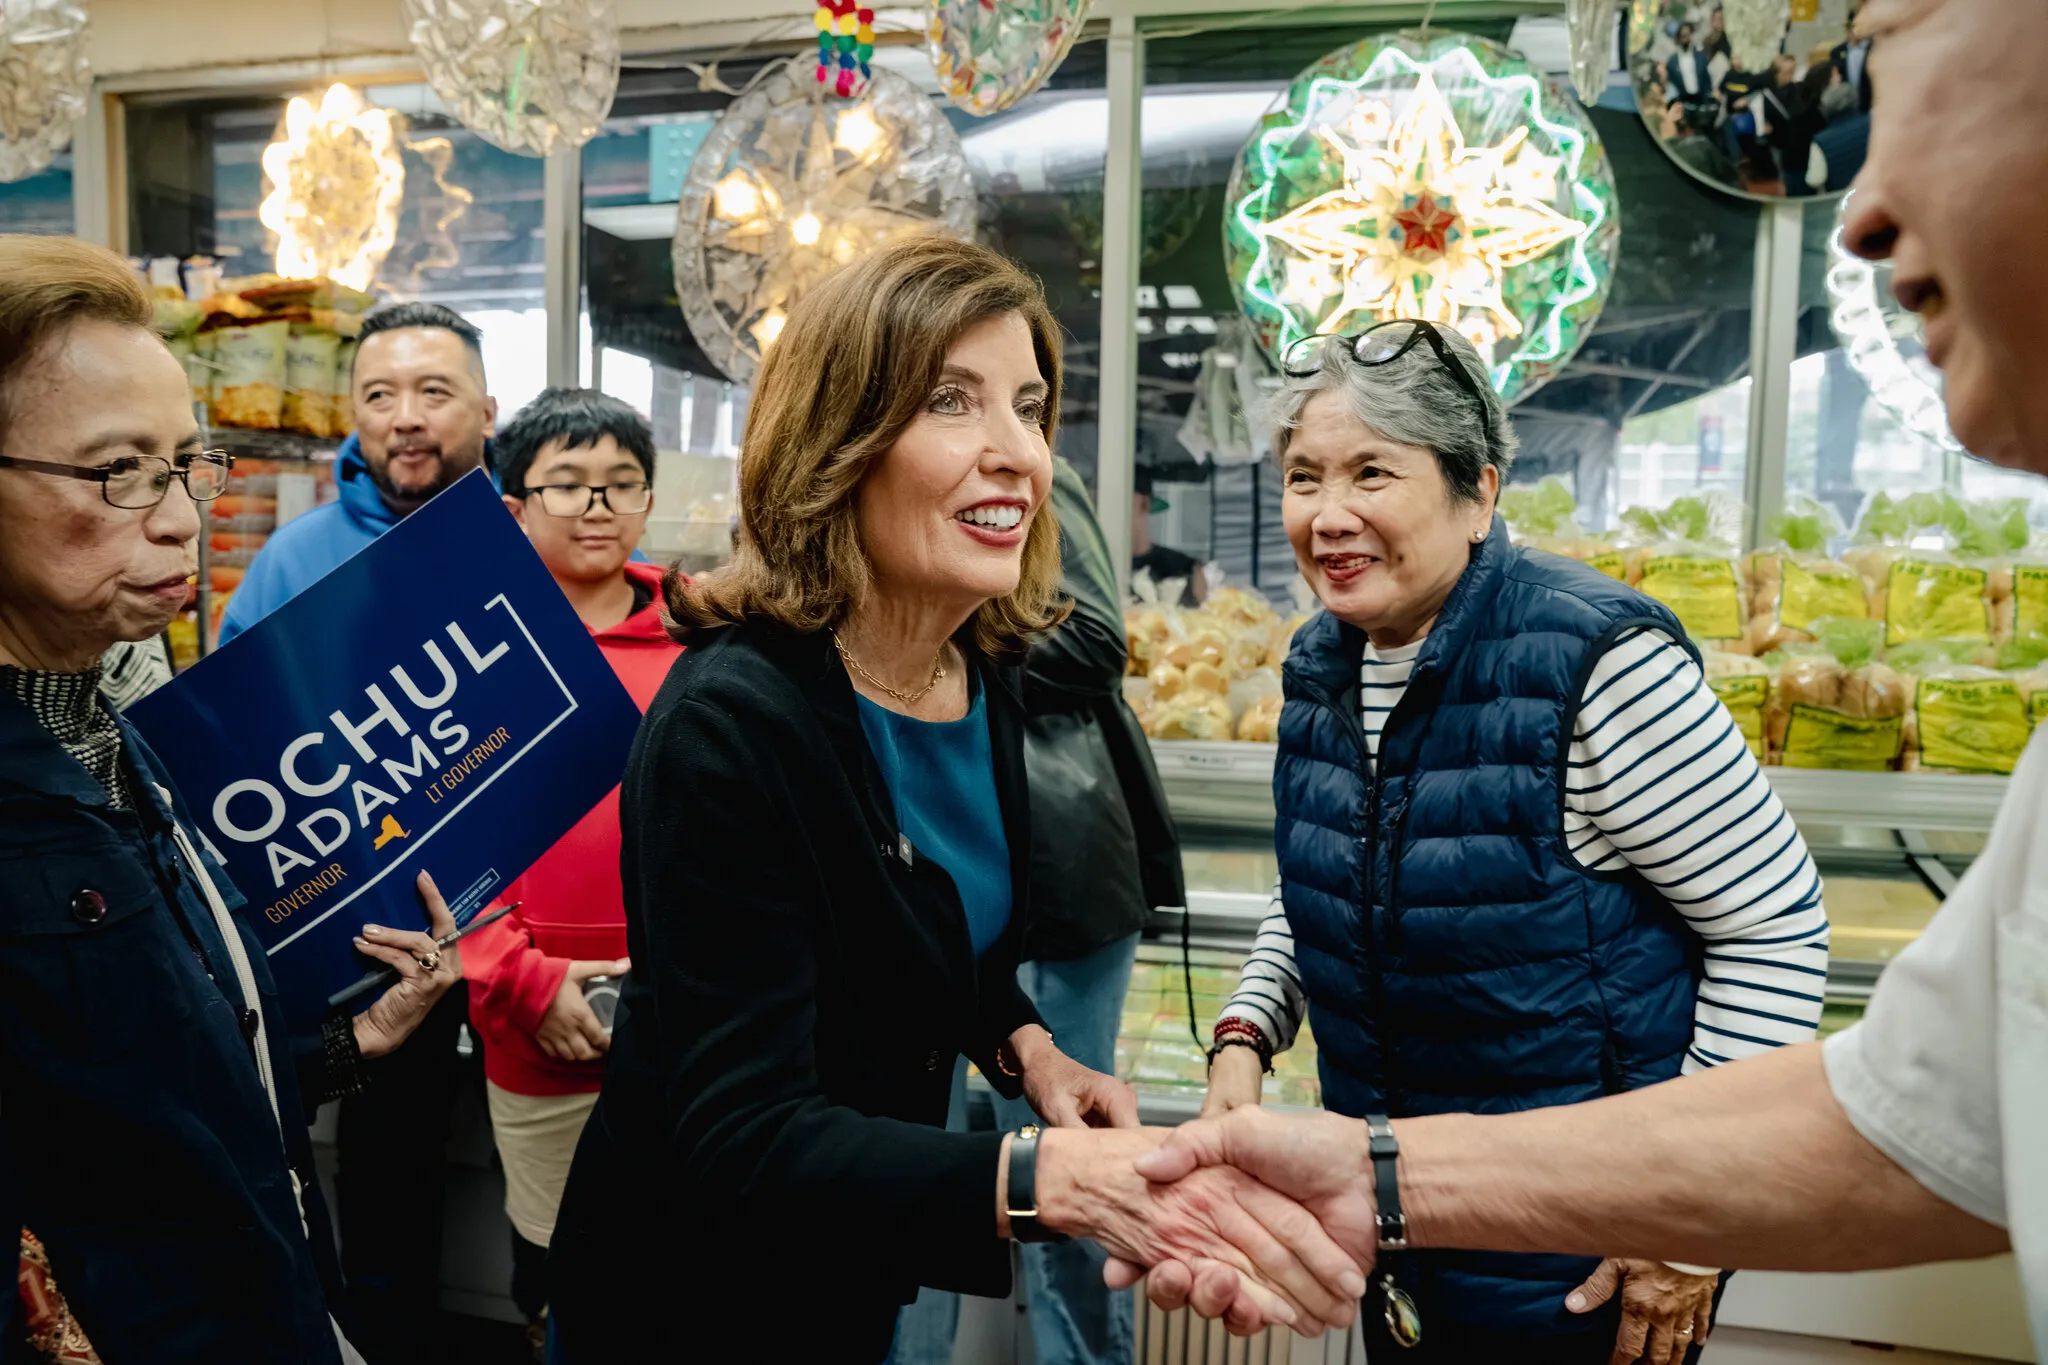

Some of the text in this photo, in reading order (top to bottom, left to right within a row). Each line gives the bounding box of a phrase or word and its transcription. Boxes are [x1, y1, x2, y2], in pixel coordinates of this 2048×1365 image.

[265, 709, 470, 889] ADAMS
[424, 726, 512, 804] LT GOVERNOR
[264, 862, 348, 924] GOVERNOR
